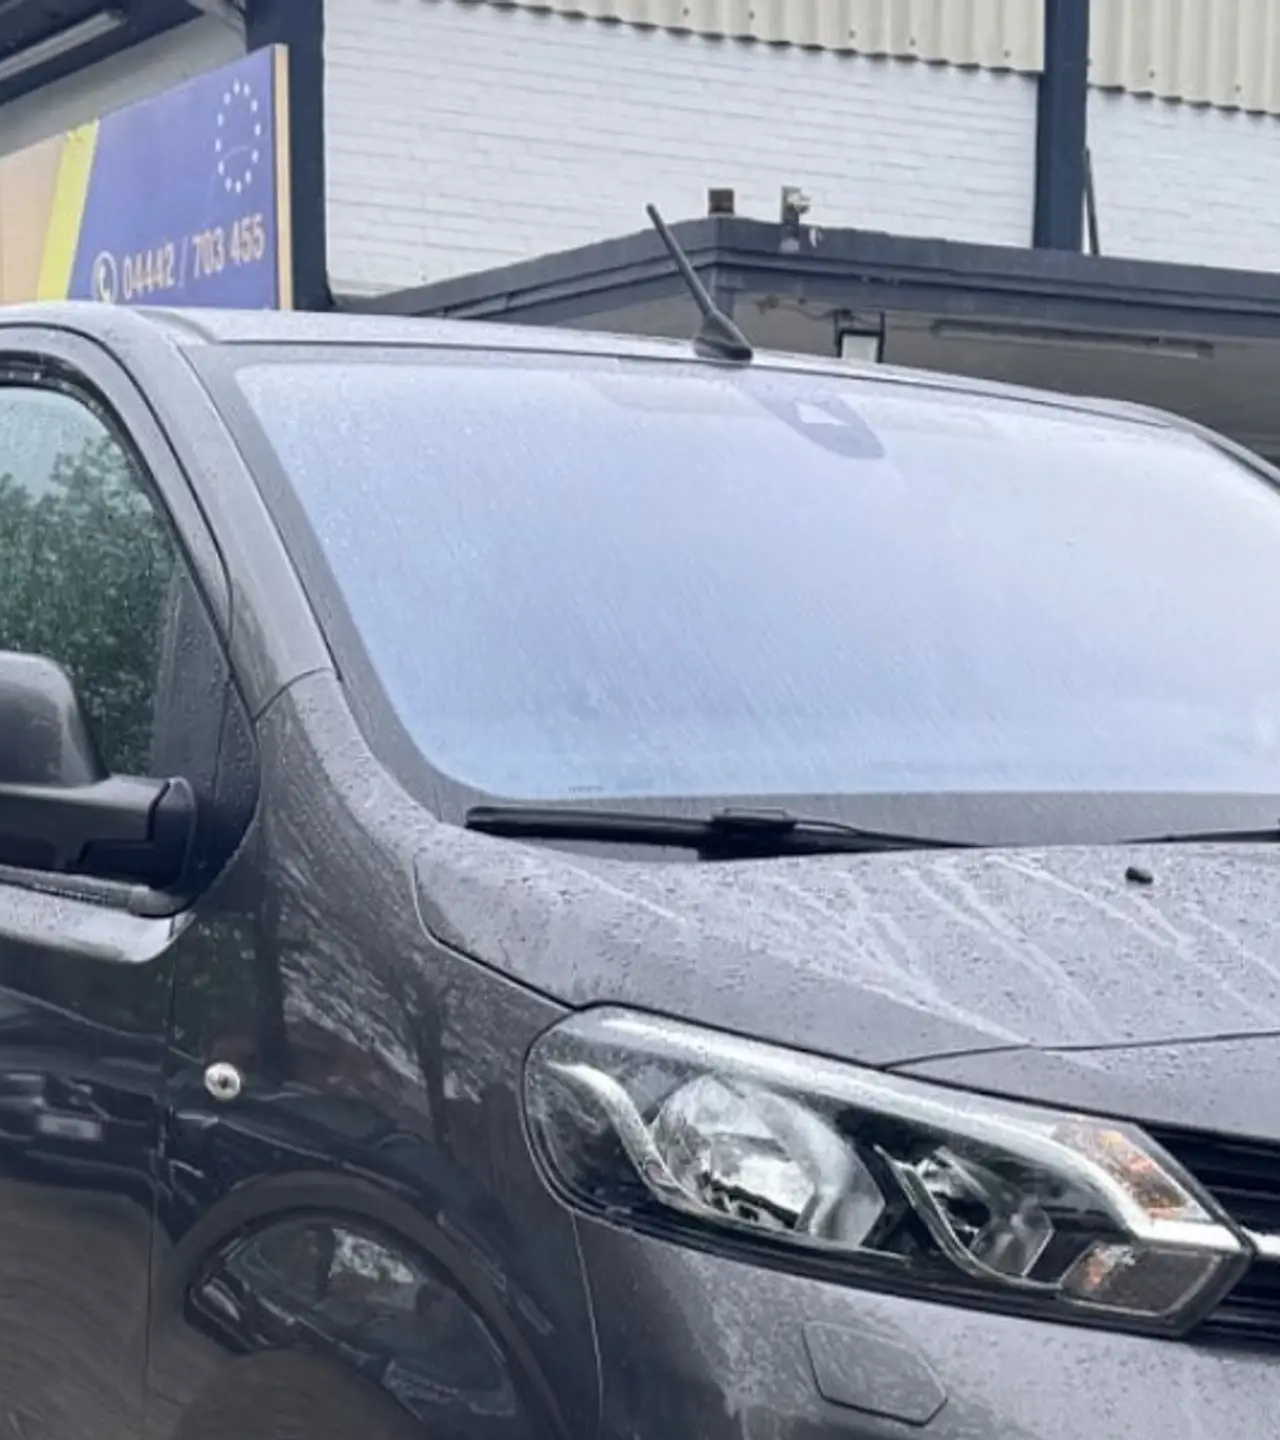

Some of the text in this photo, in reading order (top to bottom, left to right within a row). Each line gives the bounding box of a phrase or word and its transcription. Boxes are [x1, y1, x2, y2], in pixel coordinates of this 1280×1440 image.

[122, 242, 175, 300] 04442
[192, 225, 225, 279] 703
[230, 213, 266, 265] 455
